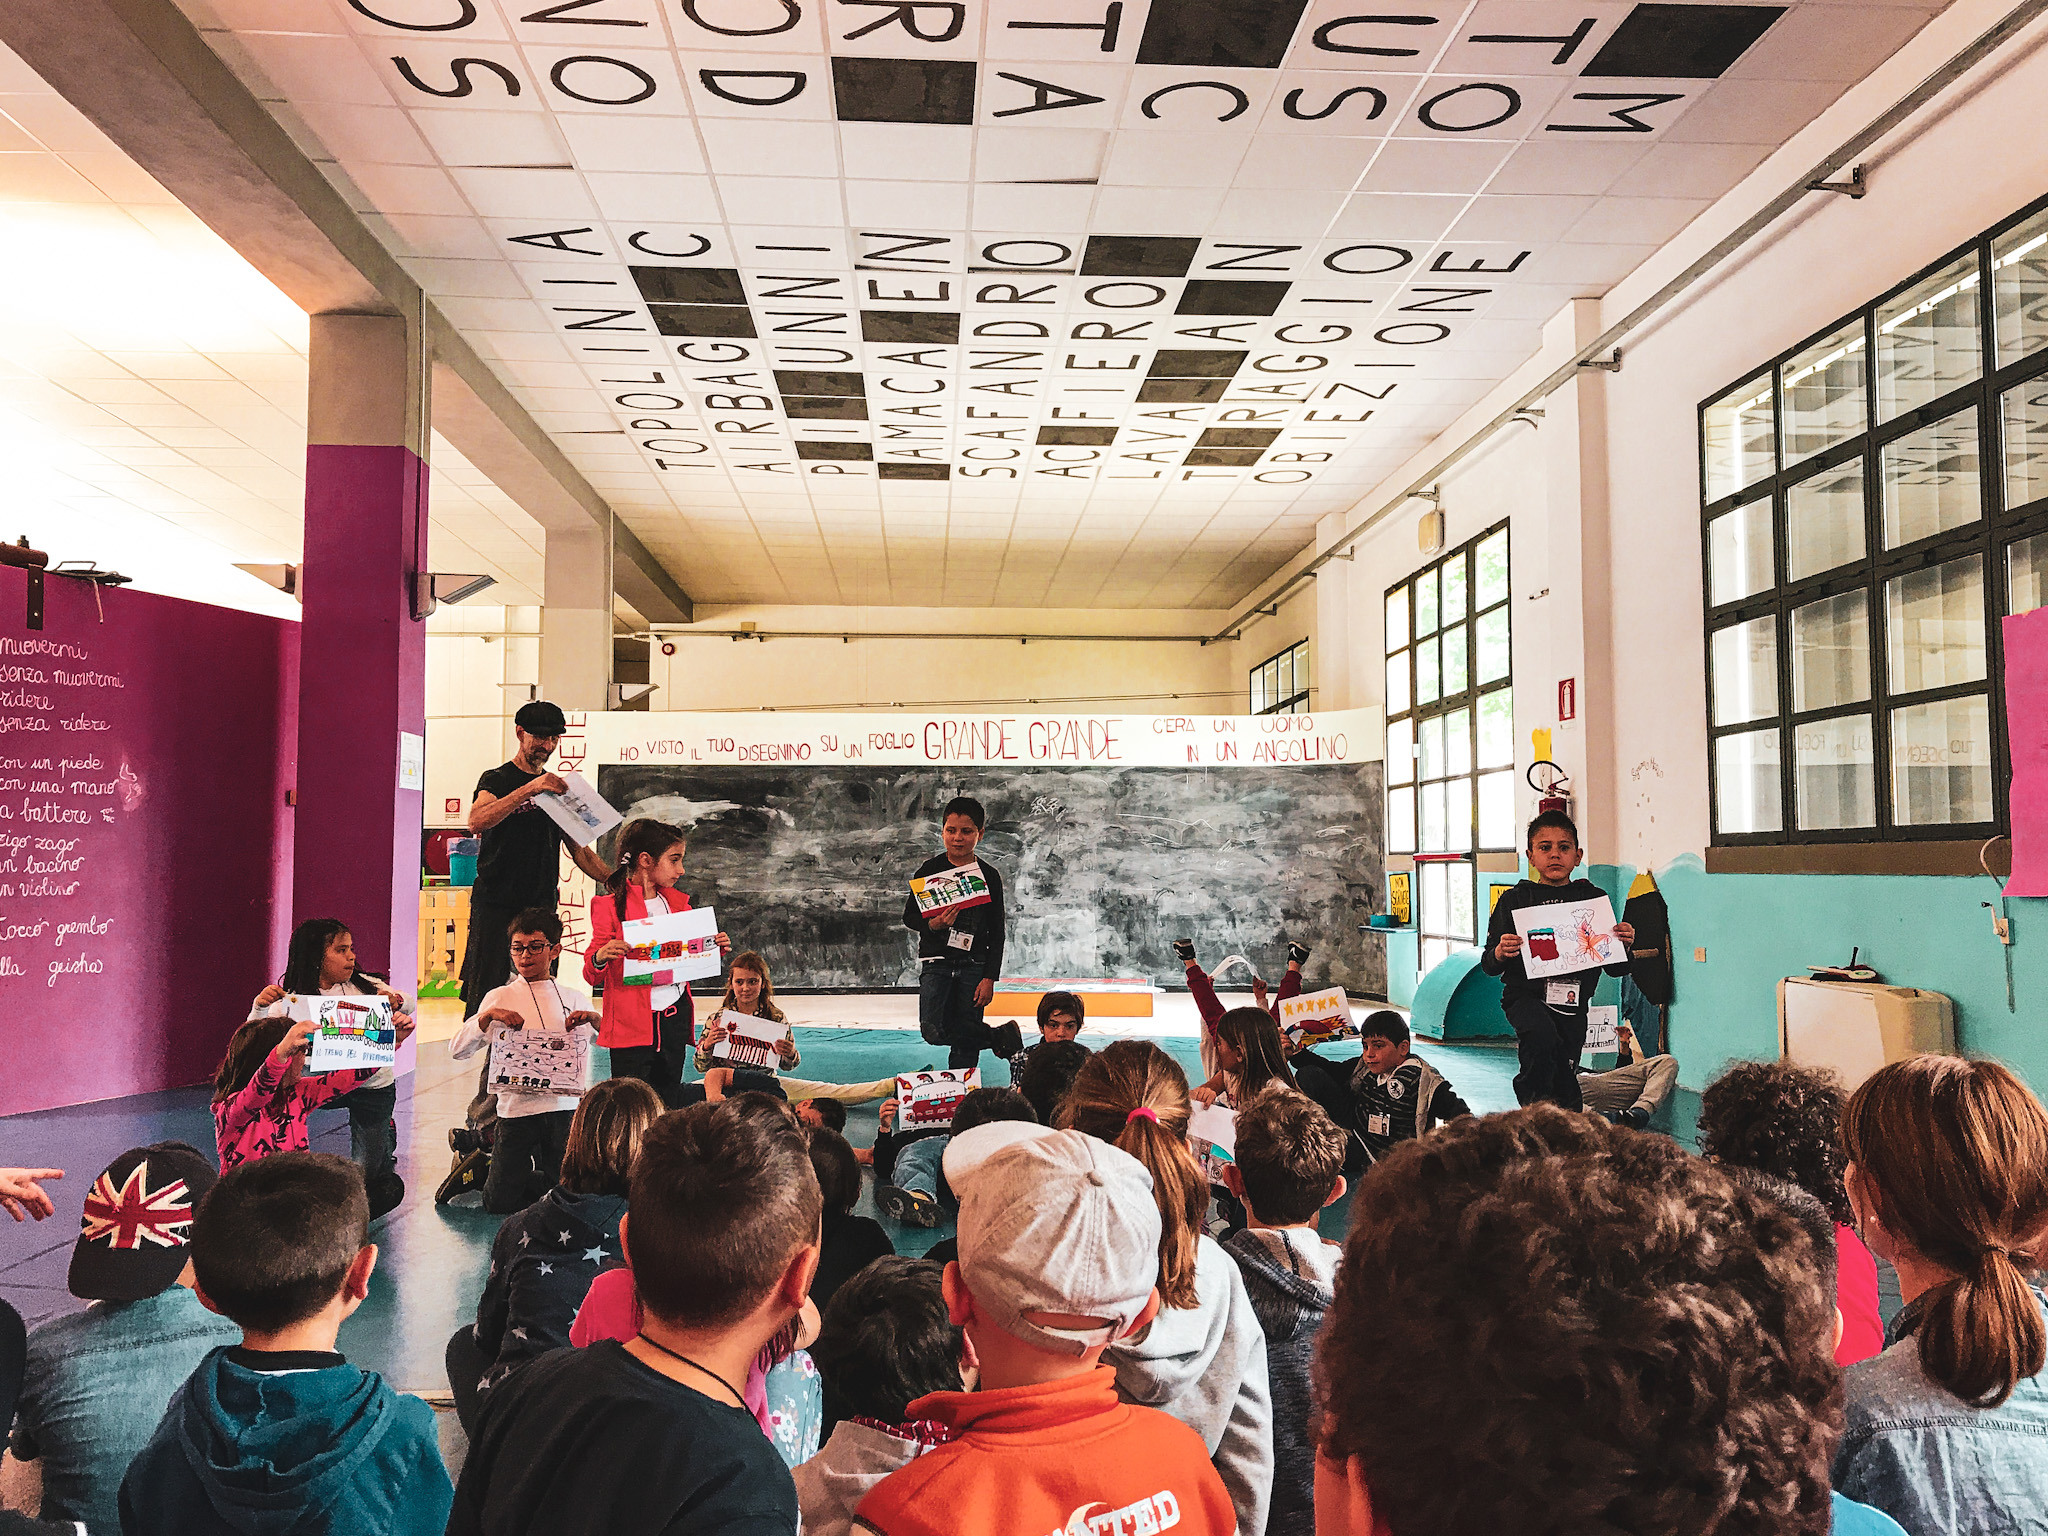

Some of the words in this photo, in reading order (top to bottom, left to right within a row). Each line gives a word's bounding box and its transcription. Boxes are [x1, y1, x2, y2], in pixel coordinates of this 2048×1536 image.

[507, 226, 716, 471] TOPOLINIA
[1217, 244, 1414, 422] RAGGIO
[958, 240, 1072, 479] SCAFANDRO
[1253, 250, 1532, 484] OBIEZIONE
[677, 341, 796, 474] AIRBAG
[877, 348, 948, 461] AMACA
[1107, 407, 1206, 478] LAVA
[53, 669, 125, 689] muovermi
[0, 687, 55, 711] ridere
[60, 712, 111, 732] ridere
[1152, 717, 1197, 735] C'ERA
[1213, 718, 1237, 733] UN
[1260, 715, 1315, 733] UOMO
[619, 746, 640, 762] HO
[646, 740, 685, 755] VISTO
[690, 748, 703, 761] IL
[706, 737, 736, 753] TUO
[738, 742, 812, 762] DISEGNINO
[820, 735, 839, 752] SU
[843, 743, 863, 759] UN
[868, 732, 916, 750] FOGLIO
[923, 719, 1020, 761] GRANDE
[1028, 719, 1124, 761] GRANDE
[1186, 744, 1200, 764] IN
[1215, 740, 1239, 762] UN
[1252, 732, 1349, 764] ANGOLINO
[30, 757, 53, 771] un
[58, 753, 104, 779] piede
[29, 780, 65, 794] una
[70, 779, 119, 795] mano
[20, 797, 91, 825] battere
[23, 855, 85, 874] bacino
[34, 838, 80, 862] zago
[19, 877, 80, 897] violino
[55, 915, 114, 947] grembo
[47, 952, 104, 988] geisha
